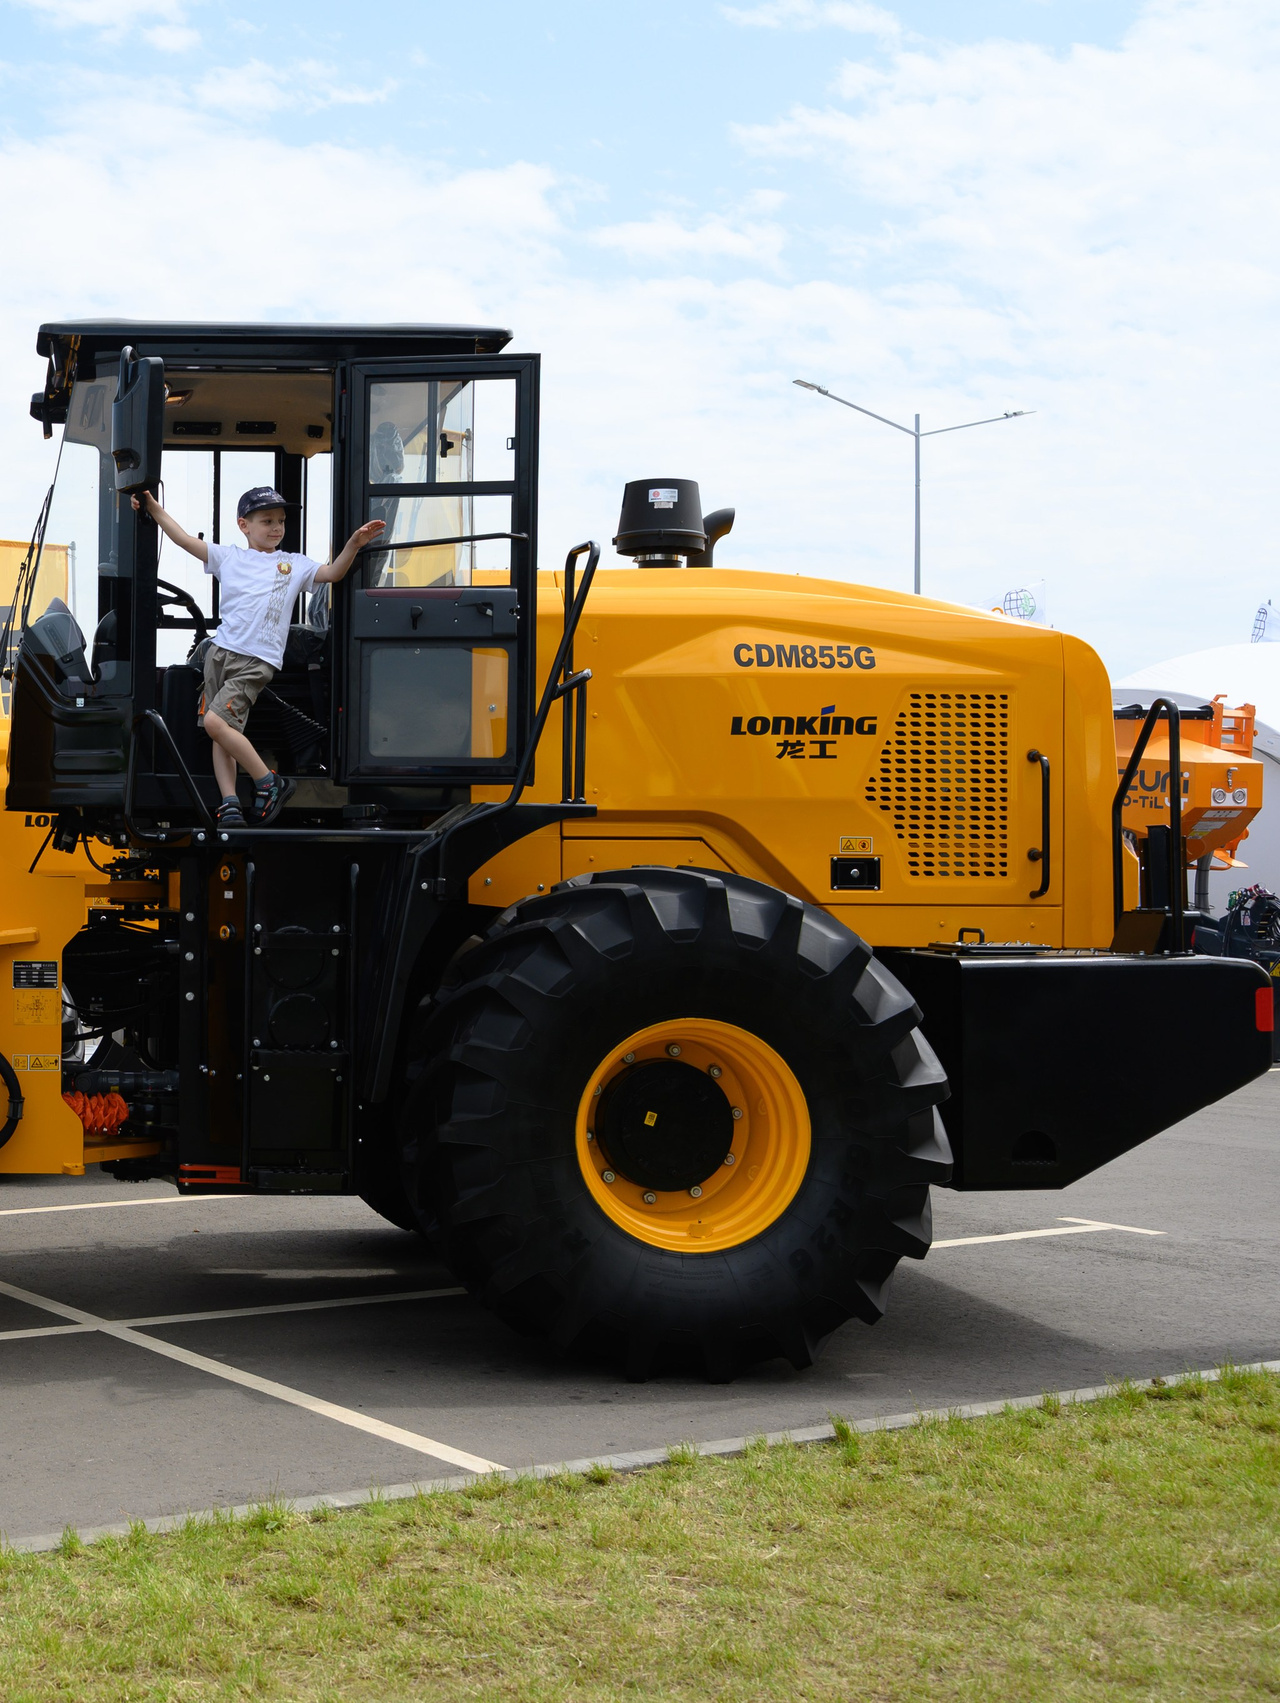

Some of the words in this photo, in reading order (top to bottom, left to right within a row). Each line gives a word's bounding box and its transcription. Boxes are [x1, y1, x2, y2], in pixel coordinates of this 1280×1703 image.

[733, 643, 876, 669] CDM855G
[730, 704, 877, 735] LONKING
[776, 740, 837, 759] 龙工
